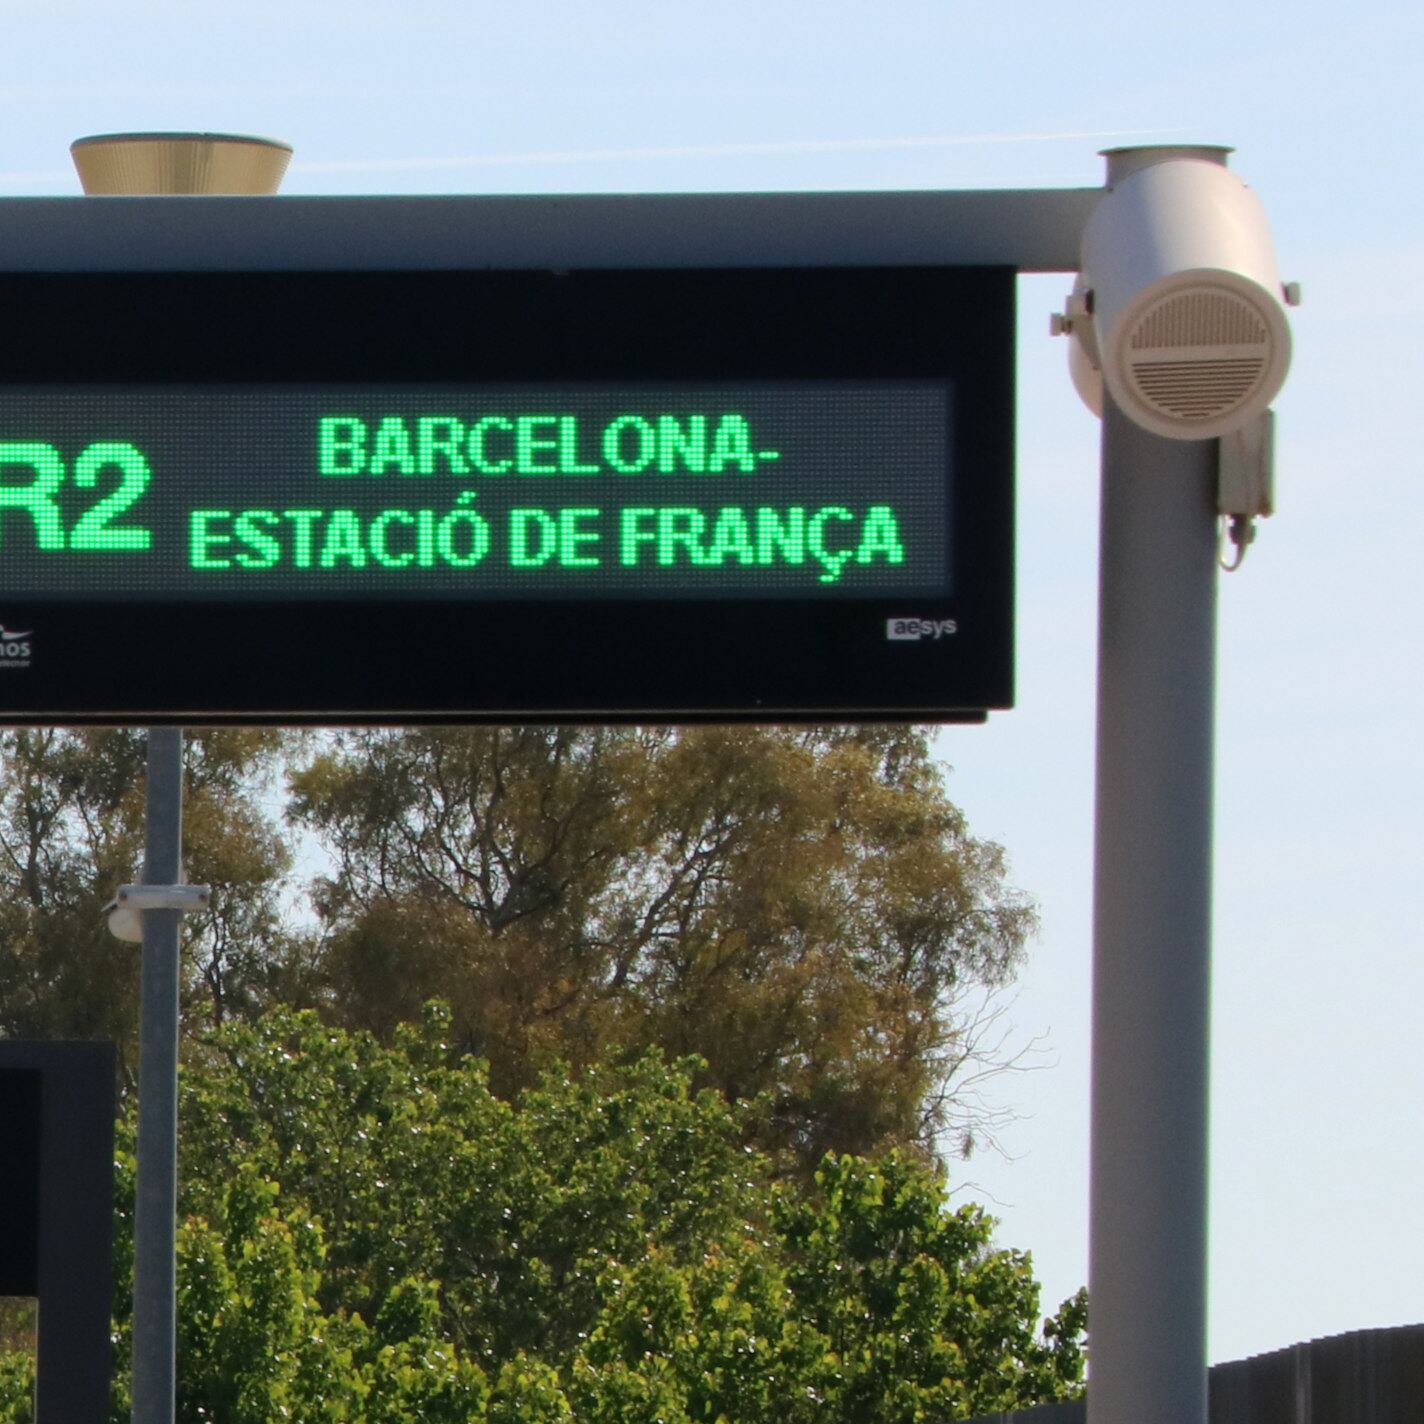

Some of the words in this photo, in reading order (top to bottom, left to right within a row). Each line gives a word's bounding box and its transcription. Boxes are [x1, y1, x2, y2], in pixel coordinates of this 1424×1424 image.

[317, 414, 780, 476] BARCELONA-
[188, 491, 491, 570] ESTACIÓ
[508, 508, 602, 568] DE
[619, 505, 905, 583] FRANÇA
